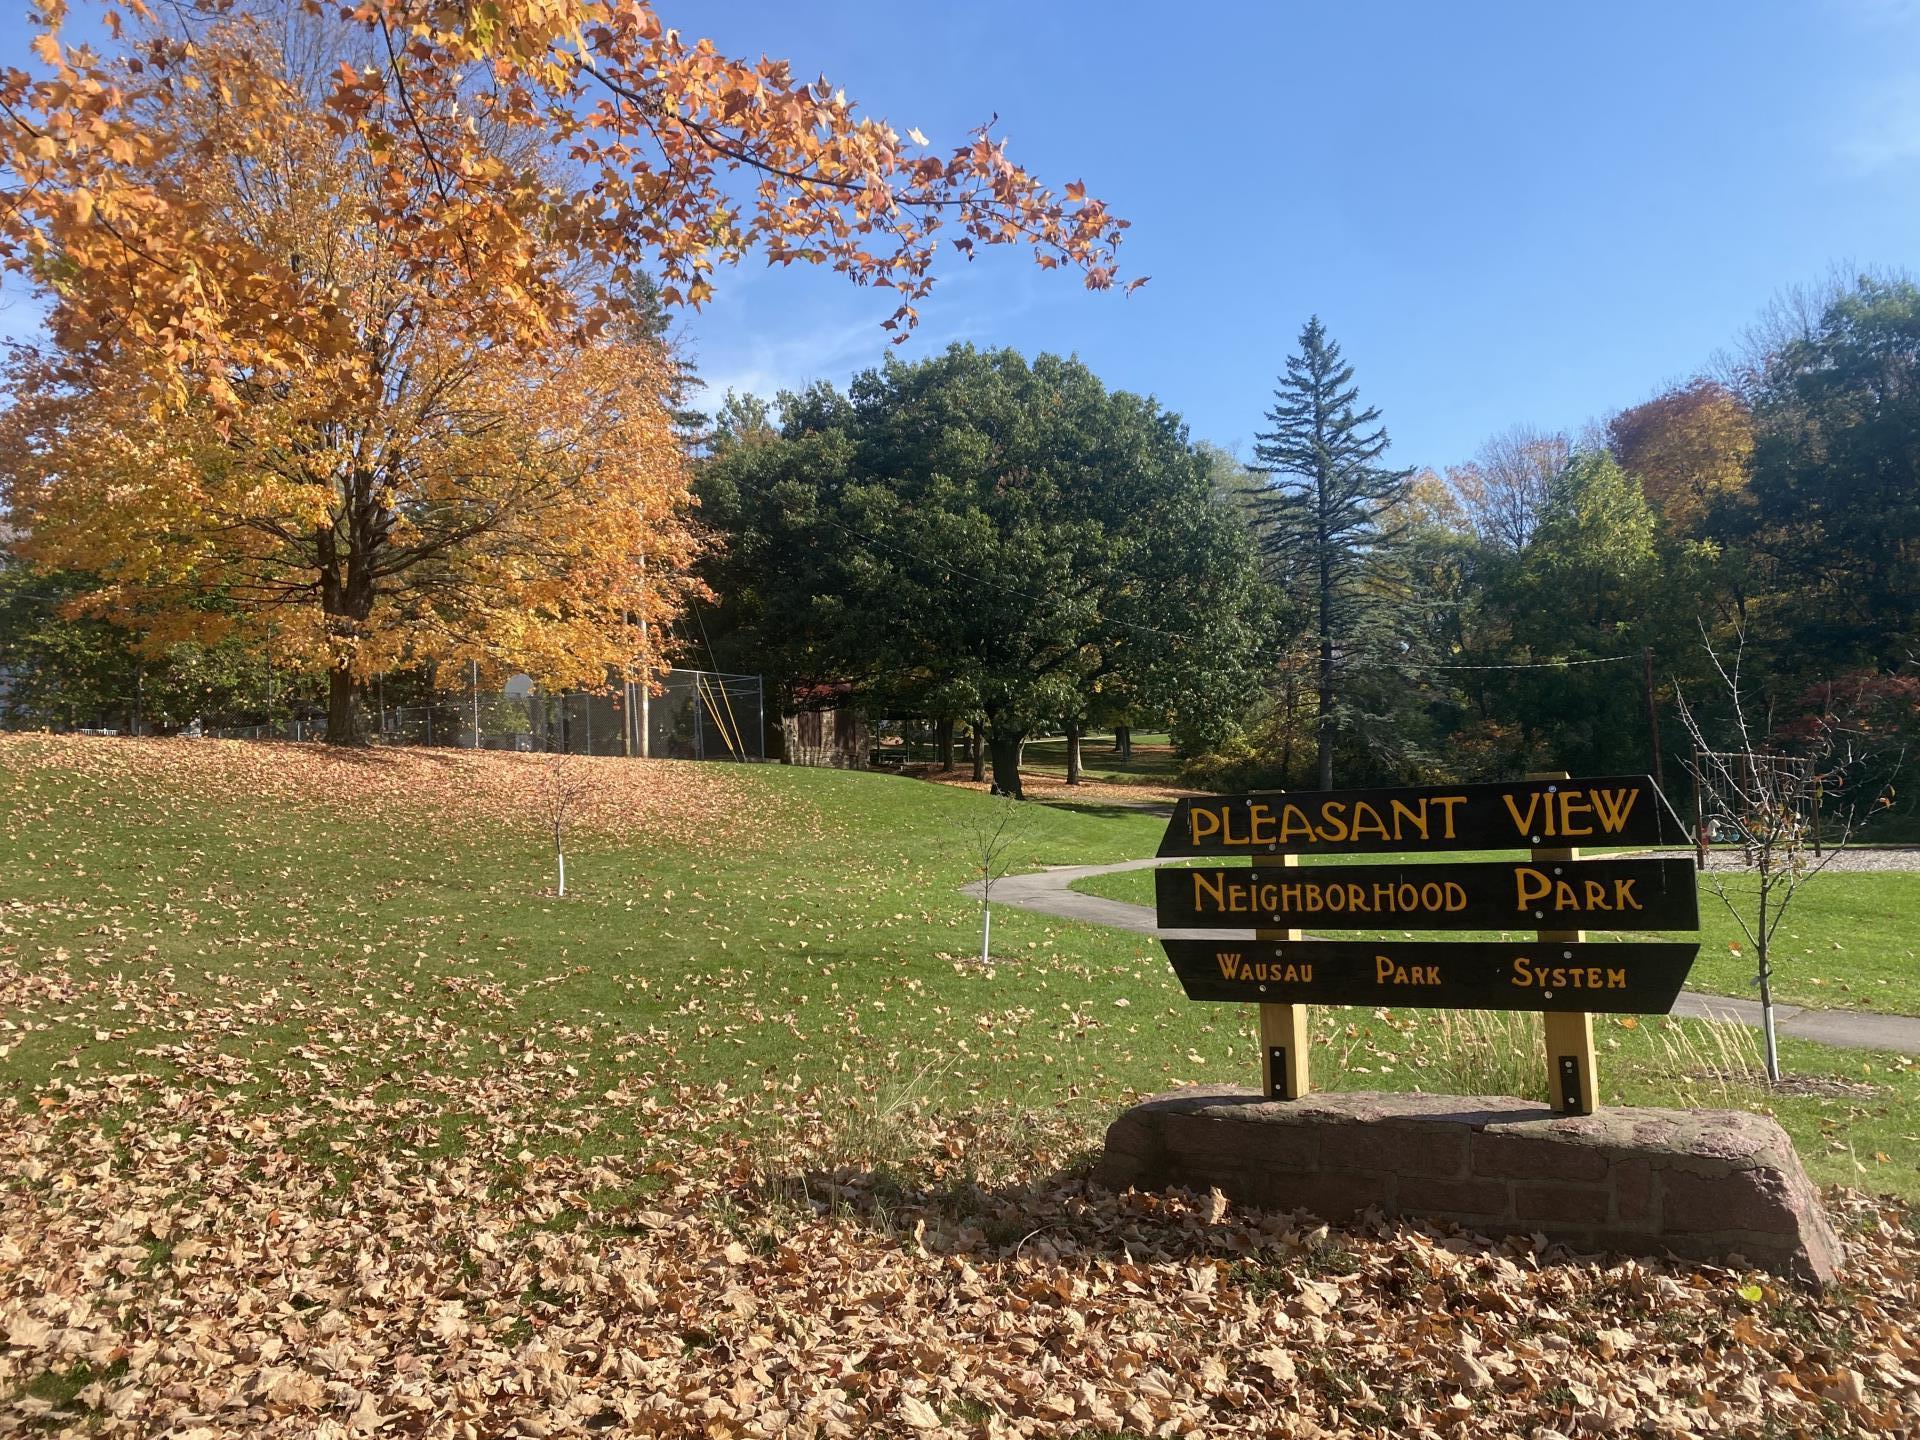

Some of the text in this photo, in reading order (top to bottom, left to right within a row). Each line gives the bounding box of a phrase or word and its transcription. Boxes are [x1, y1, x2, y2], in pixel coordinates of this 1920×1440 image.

[1191, 788, 1639, 845] PLEASANT VIEW
[1194, 868, 1643, 912] NEIGHBORHOOD PARK
[1216, 953, 1626, 988] WAUSAU PARK SYSTEM
